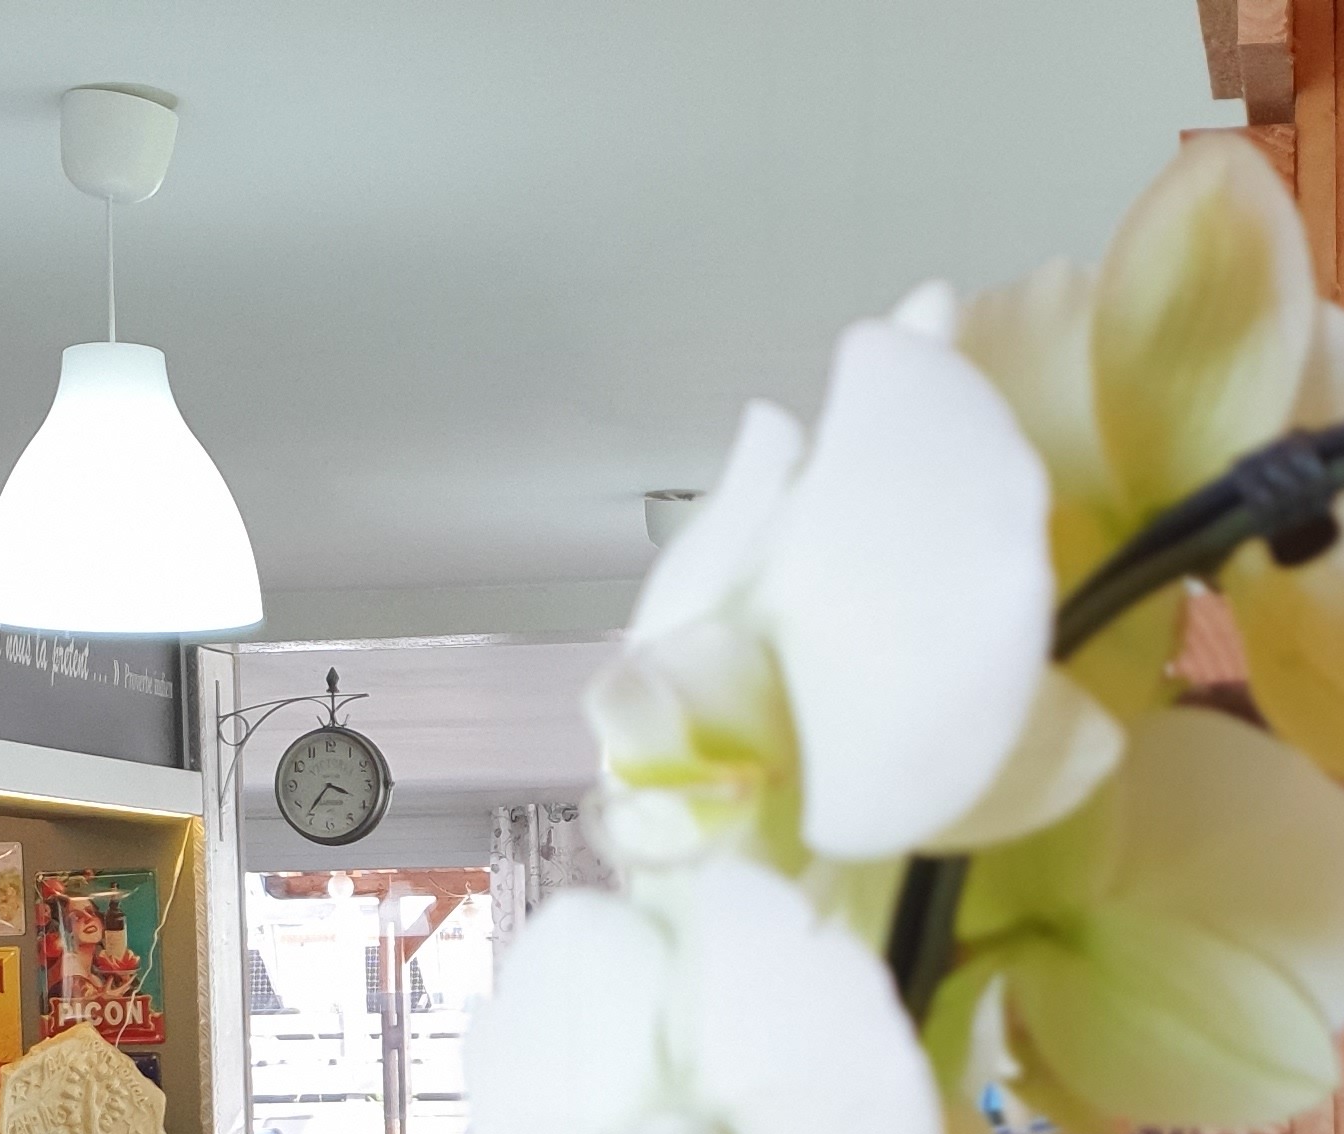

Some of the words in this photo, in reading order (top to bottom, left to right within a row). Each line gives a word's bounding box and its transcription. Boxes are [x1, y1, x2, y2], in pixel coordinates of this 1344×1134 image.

[6, 634, 32, 666] nous
[35, 631, 48, 671] la
[58, 1000, 144, 1027] PICON
